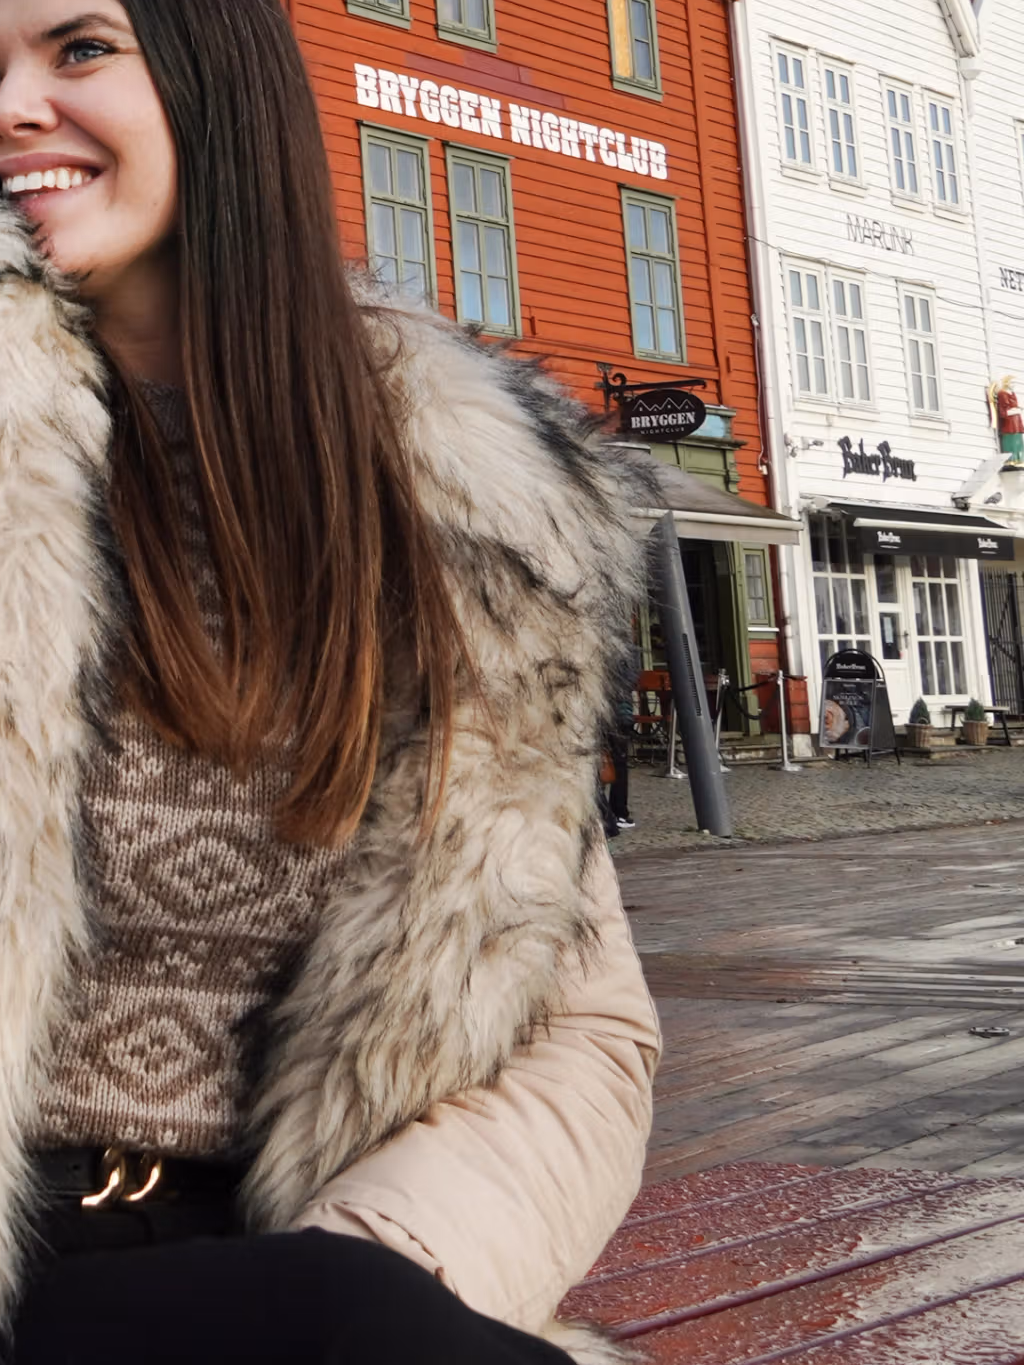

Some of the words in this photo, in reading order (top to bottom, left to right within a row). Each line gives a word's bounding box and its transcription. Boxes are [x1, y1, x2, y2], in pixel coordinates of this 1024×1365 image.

[354, 63, 503, 139] BRYGGEN
[508, 103, 668, 180] NIGHTCLUB
[631, 412, 695, 428] BRYGGEN
[640, 426, 685, 435] NIGHTCLUB
